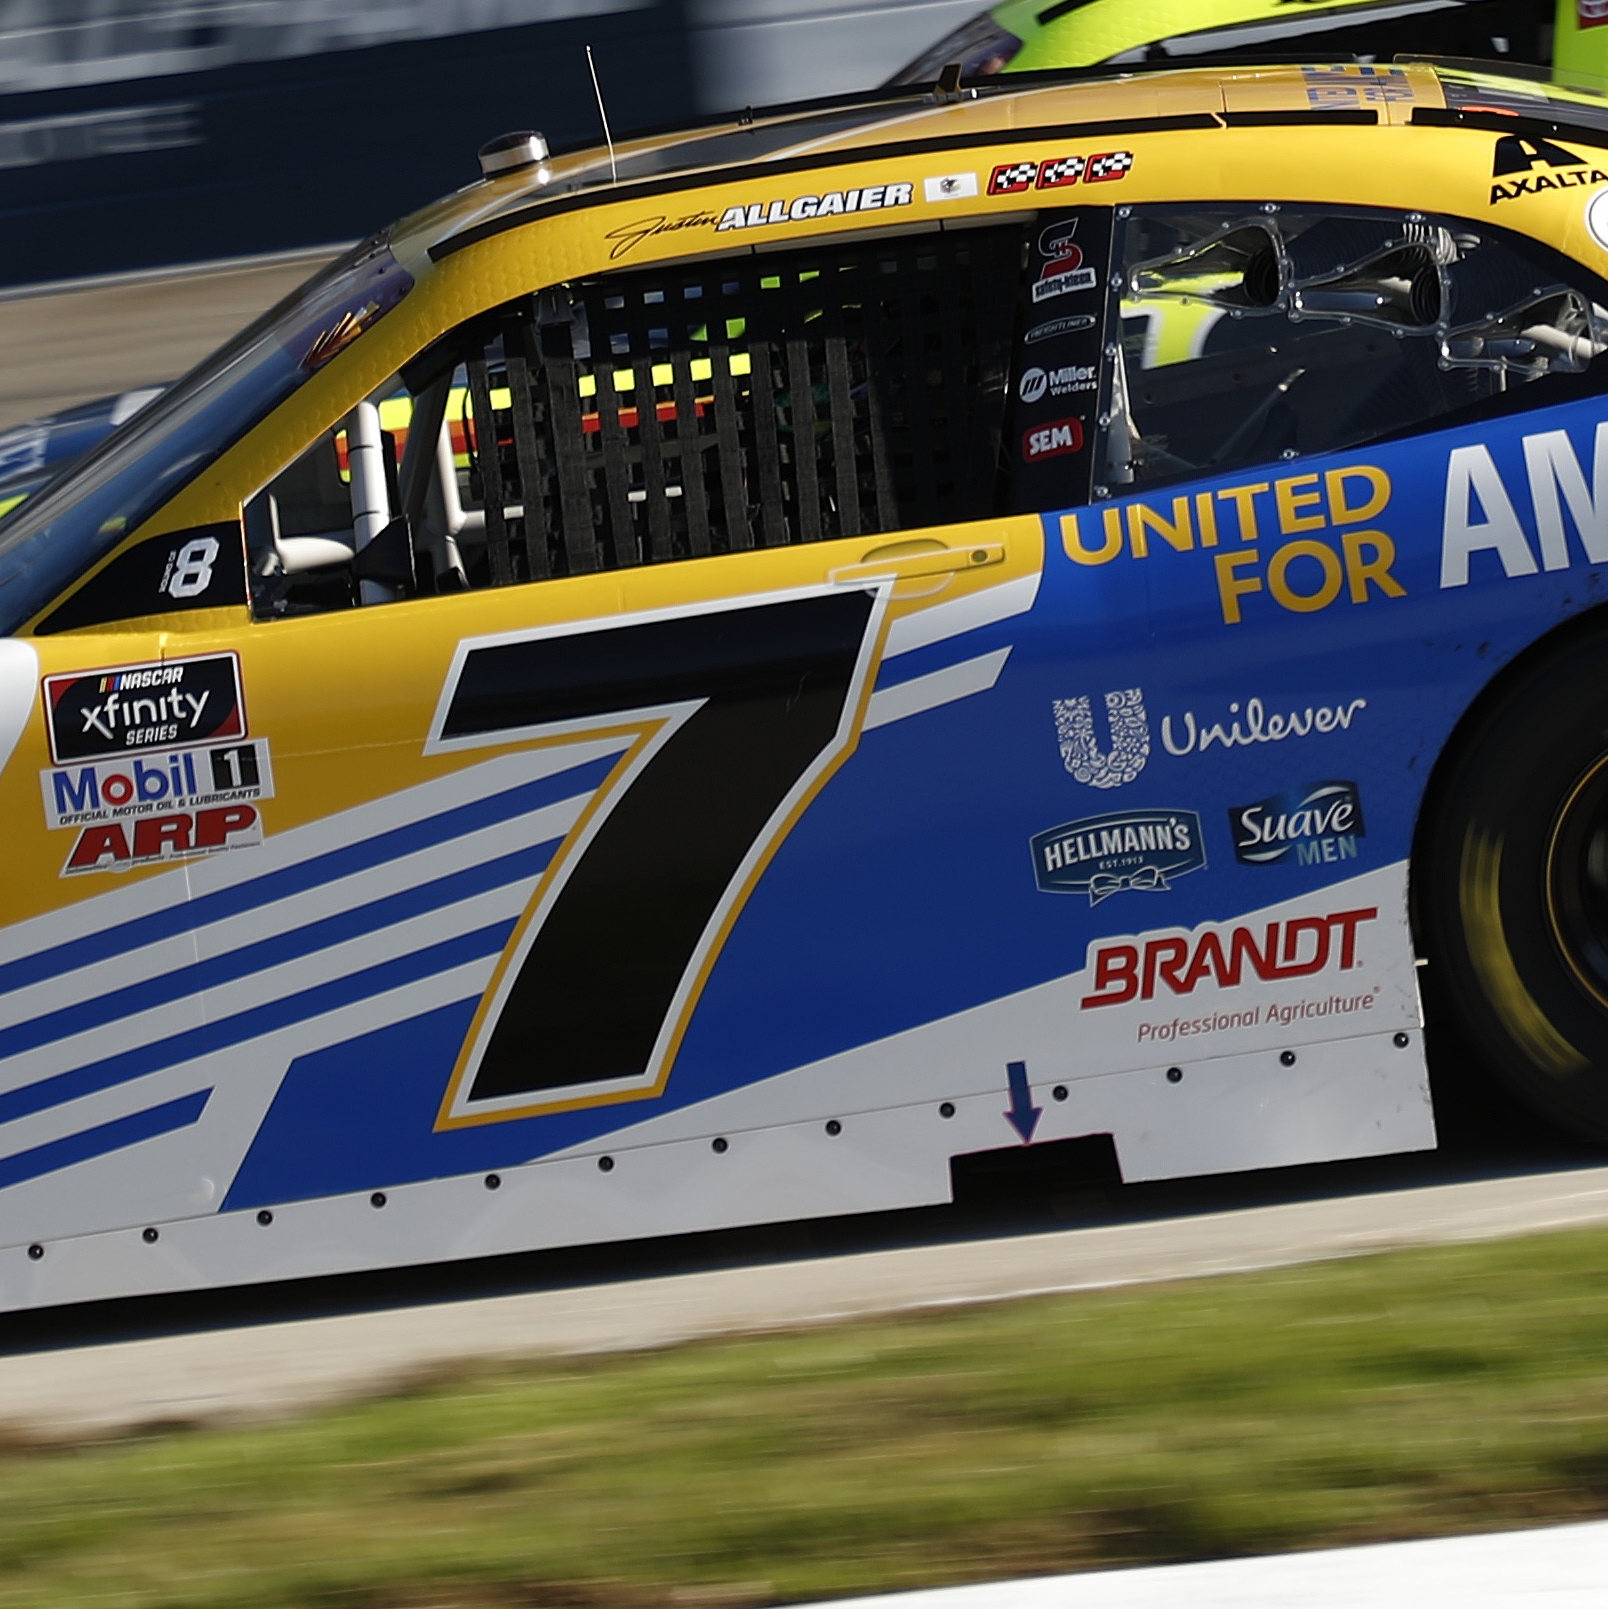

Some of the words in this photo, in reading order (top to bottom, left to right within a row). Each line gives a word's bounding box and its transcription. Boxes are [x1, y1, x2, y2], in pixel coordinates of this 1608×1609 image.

[605, 210, 719, 261] Justin
[715, 182, 914, 233] ALLGAIER
[1049, 365, 1097, 387] Miller
[1051, 380, 1098, 397] Welders
[1028, 425, 1074, 456] SEM
[1058, 465, 1391, 566] UNITED
[168, 535, 220, 599] 8
[1215, 529, 1408, 626] FOR
[119, 666, 185, 692] NASCAR
[79, 686, 210, 741] xfinity
[125, 723, 178, 746] SERIES
[1160, 697, 1368, 757] Unilever
[51, 751, 198, 815] Mobil
[59, 810, 109, 826] OFFICIAL
[112, 803, 154, 817] MOTOR
[156, 801, 174, 811] OIL
[189, 788, 261, 806] LUBRICANTS
[67, 804, 258, 869] ARP
[1044, 816, 1192, 873] HELLMANN'S
[1237, 797, 1356, 848] Suave
[1295, 834, 1359, 867] MEN
[425, 575, 897, 1133] 7
[1080, 906, 1379, 1011] BRANDT
[1137, 1005, 1261, 1044] Professional
[1265, 990, 1375, 1027] Agriculture
